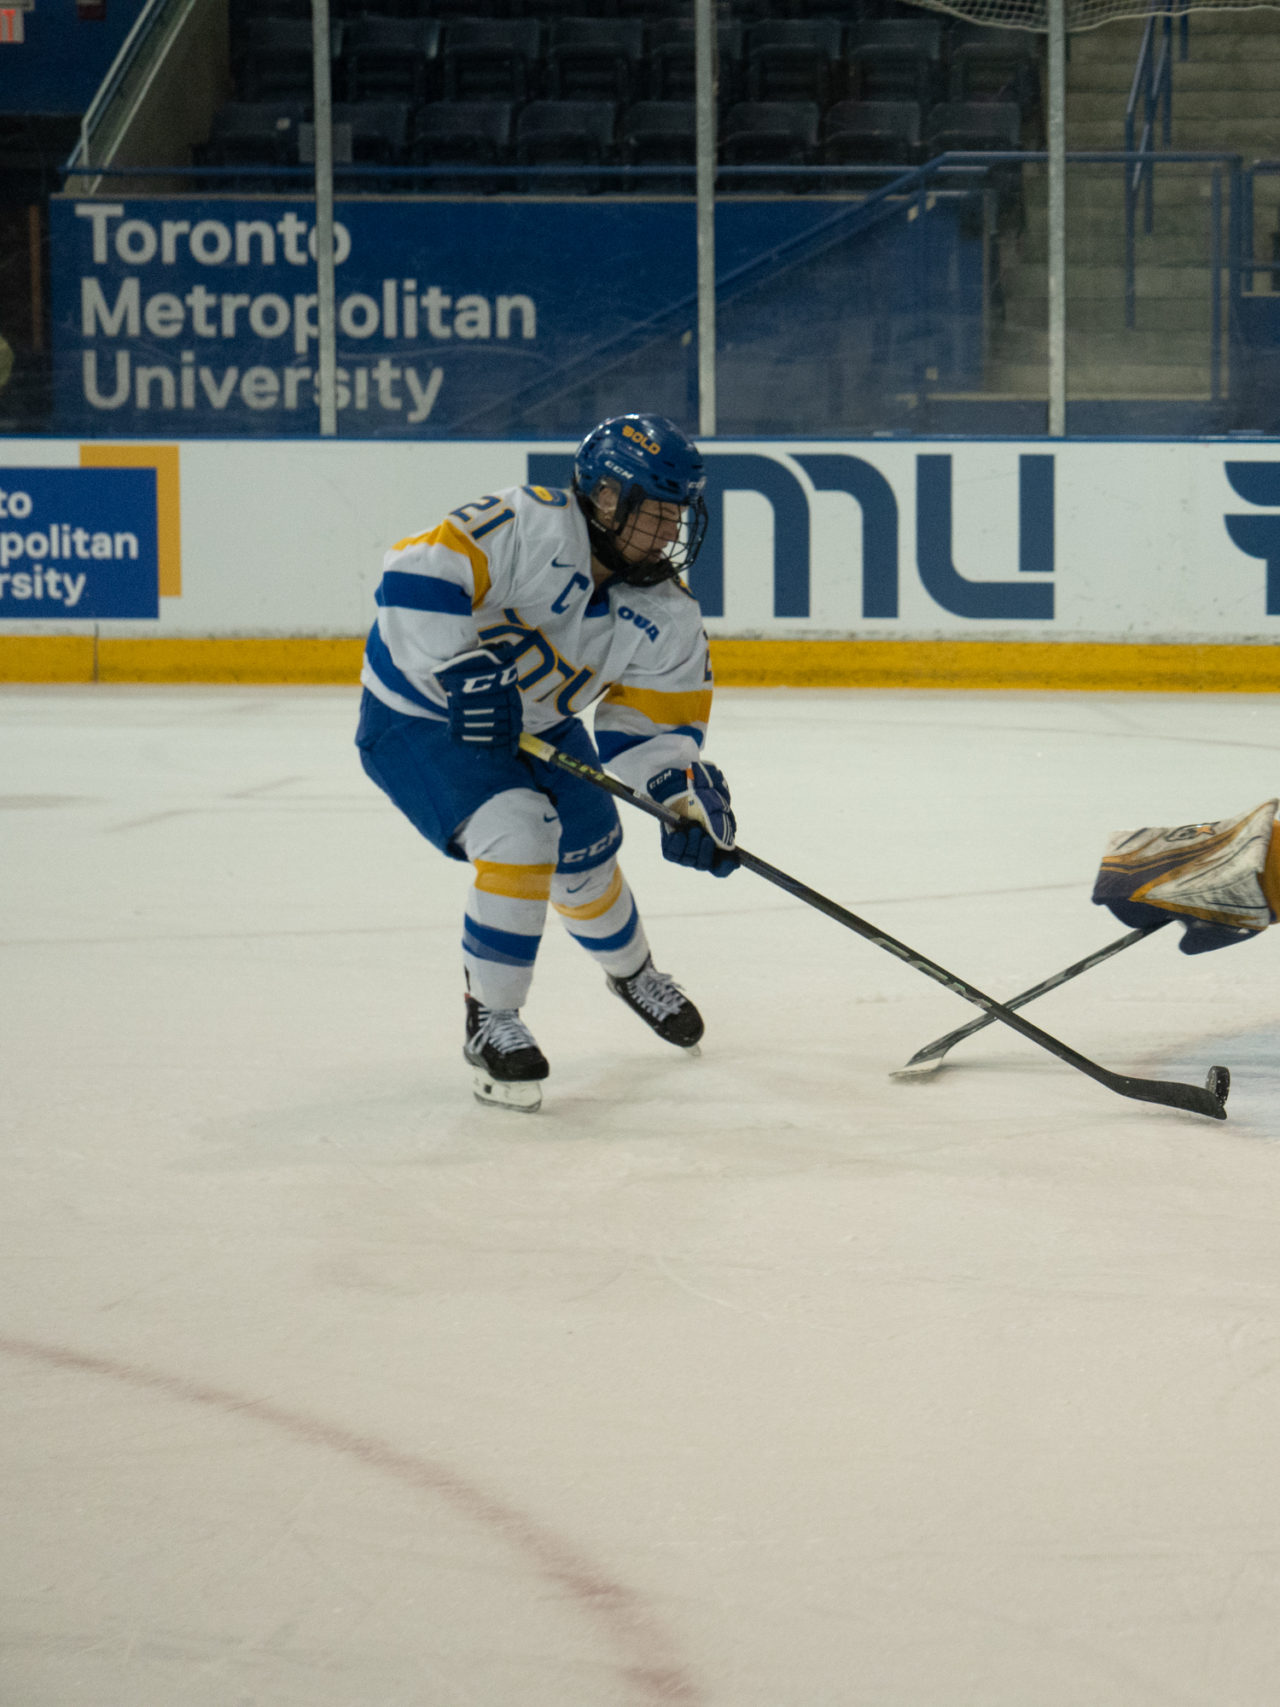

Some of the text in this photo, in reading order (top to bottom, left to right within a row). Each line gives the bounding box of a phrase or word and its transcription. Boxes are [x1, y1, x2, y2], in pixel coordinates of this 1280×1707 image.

[75, 204, 351, 265] Toronto
[81, 278, 537, 353] Metropolitan
[82, 350, 444, 422] University
[622, 425, 661, 455] BOLD
[604, 460, 634, 480] CCM
[449, 495, 516, 540] 21
[551, 572, 590, 615] C
[617, 605, 661, 643] OUA
